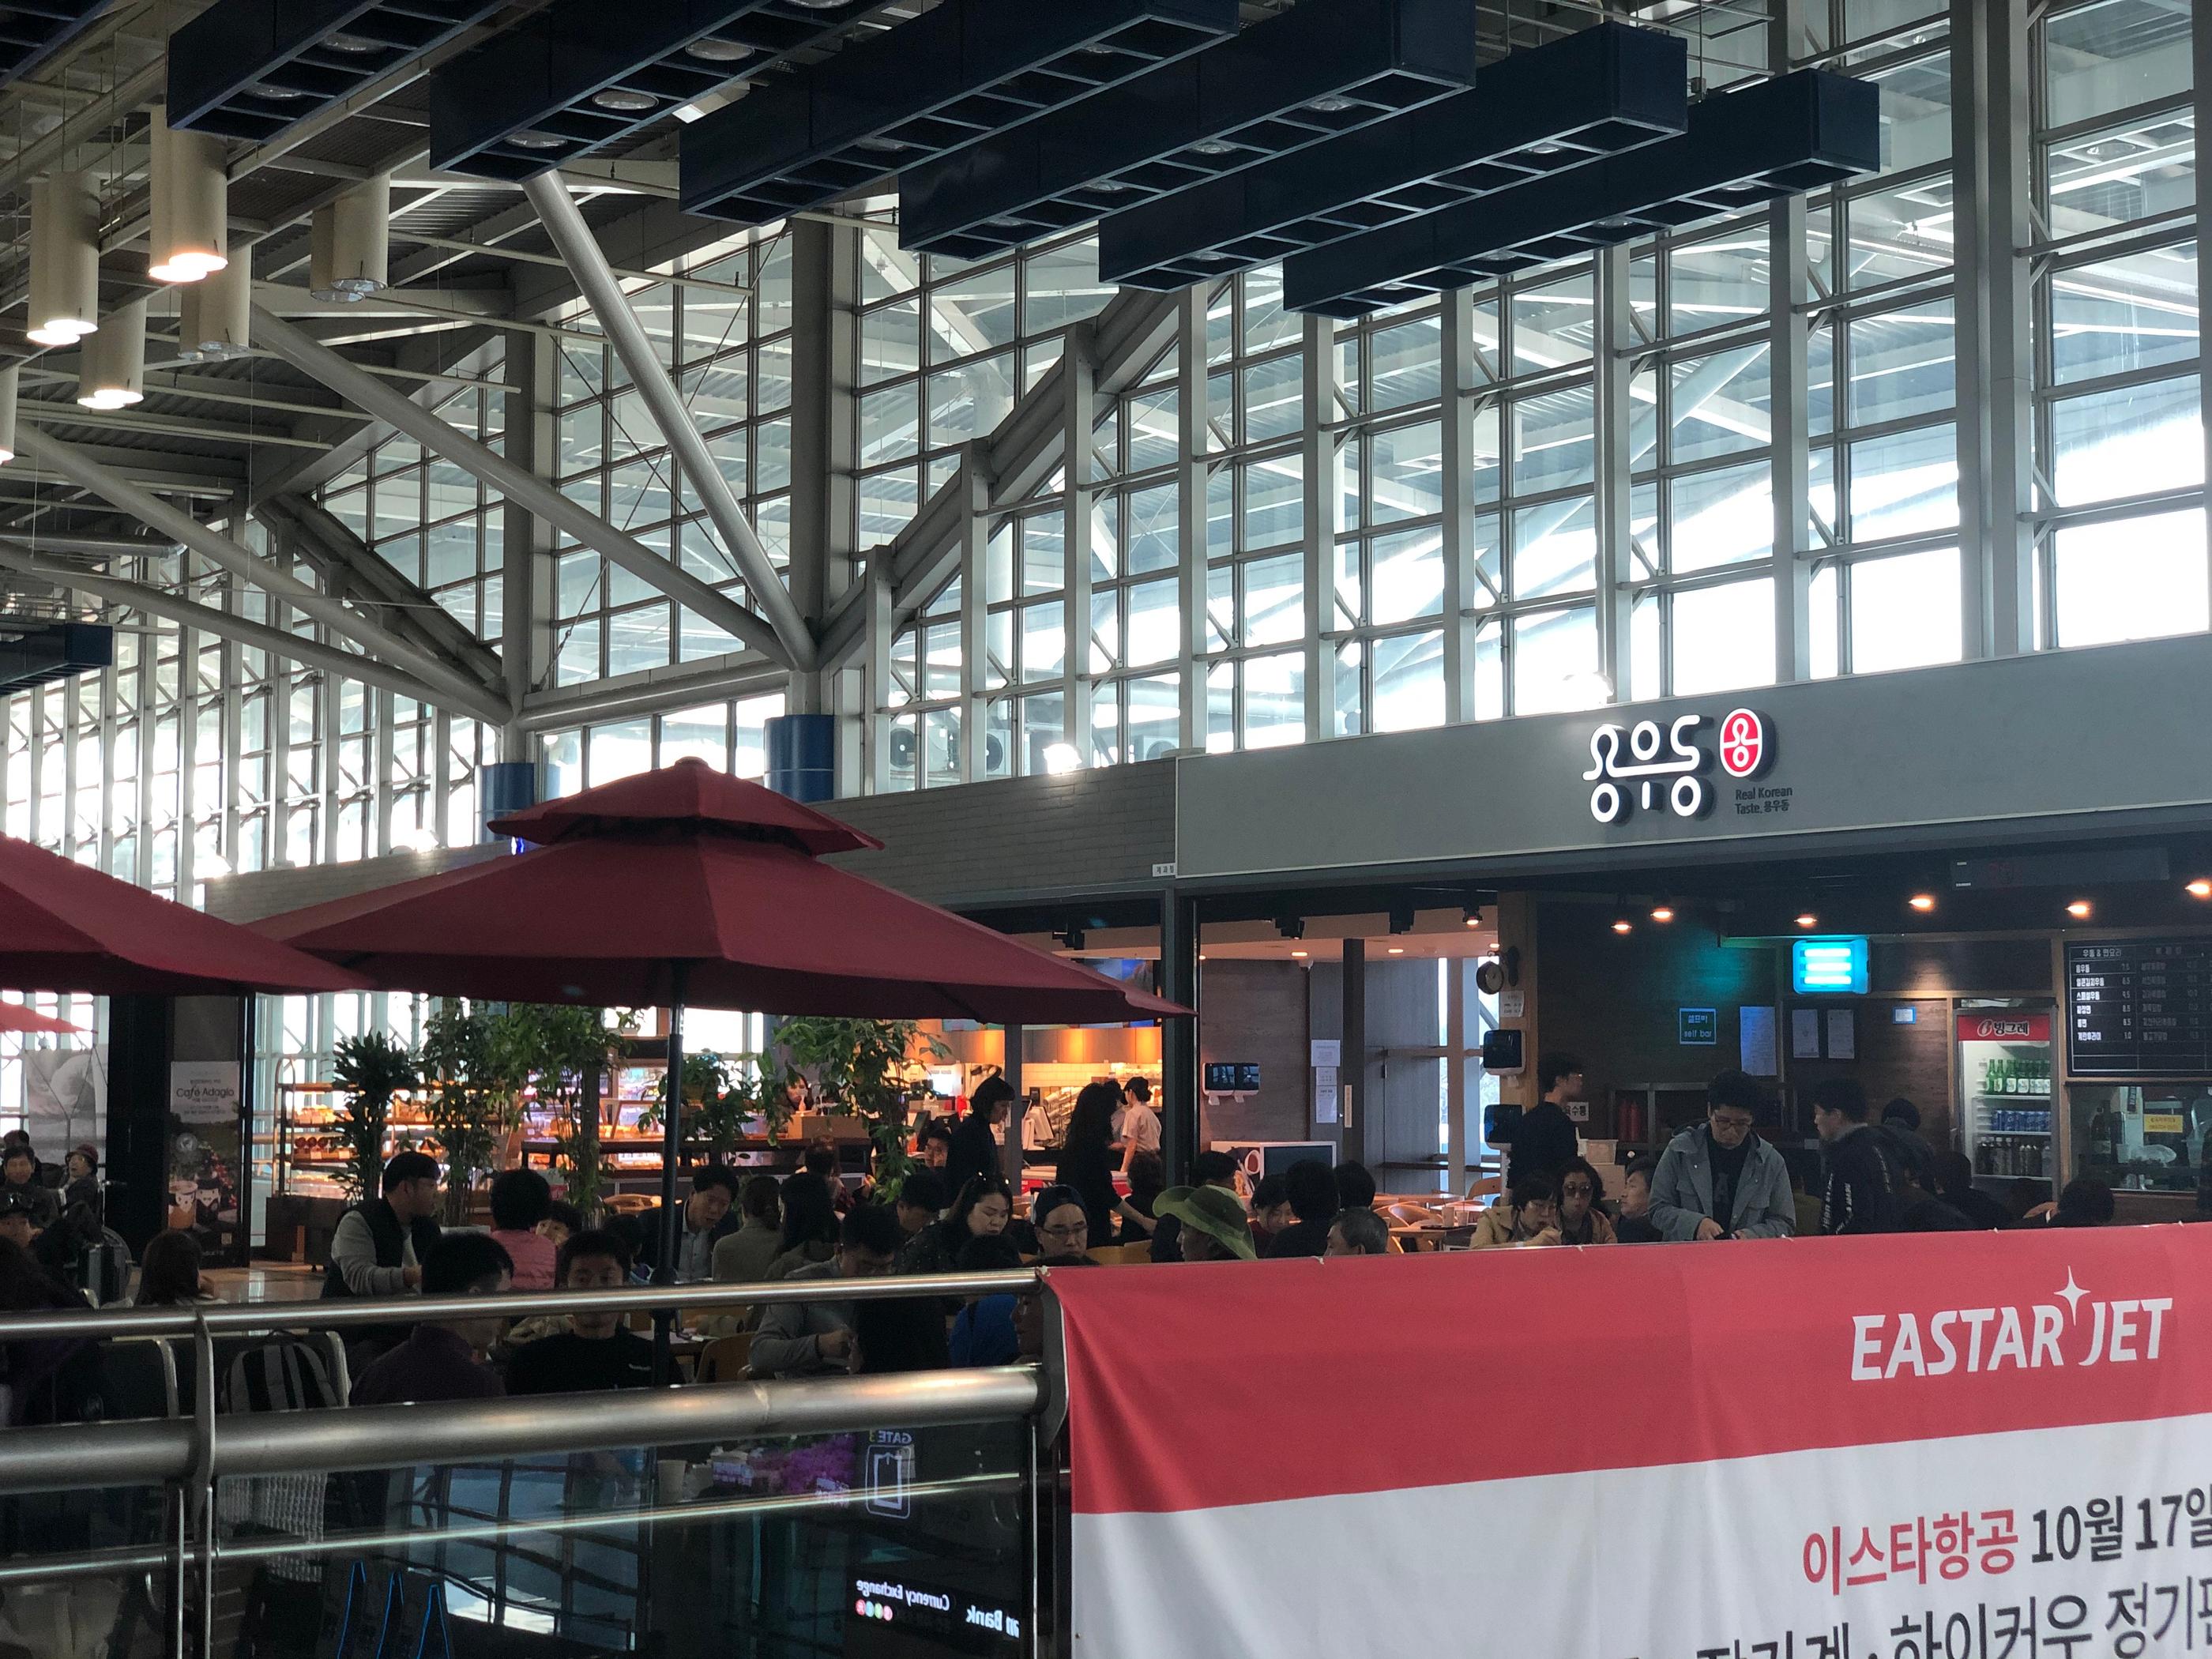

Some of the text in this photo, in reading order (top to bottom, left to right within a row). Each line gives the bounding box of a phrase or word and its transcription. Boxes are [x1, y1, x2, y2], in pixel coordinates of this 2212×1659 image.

[1736, 787, 1793, 800] Real Korean
[1734, 799, 1790, 814] Taste. 용우동
[1993, 1020, 2030, 1036] 빙그레
[203, 1087, 235, 1098] Adagio
[1851, 1298, 2174, 1381] EASTAR JET
[1803, 1509, 2018, 1596] 이스타항공
[2031, 1495, 2124, 1563] 10월
